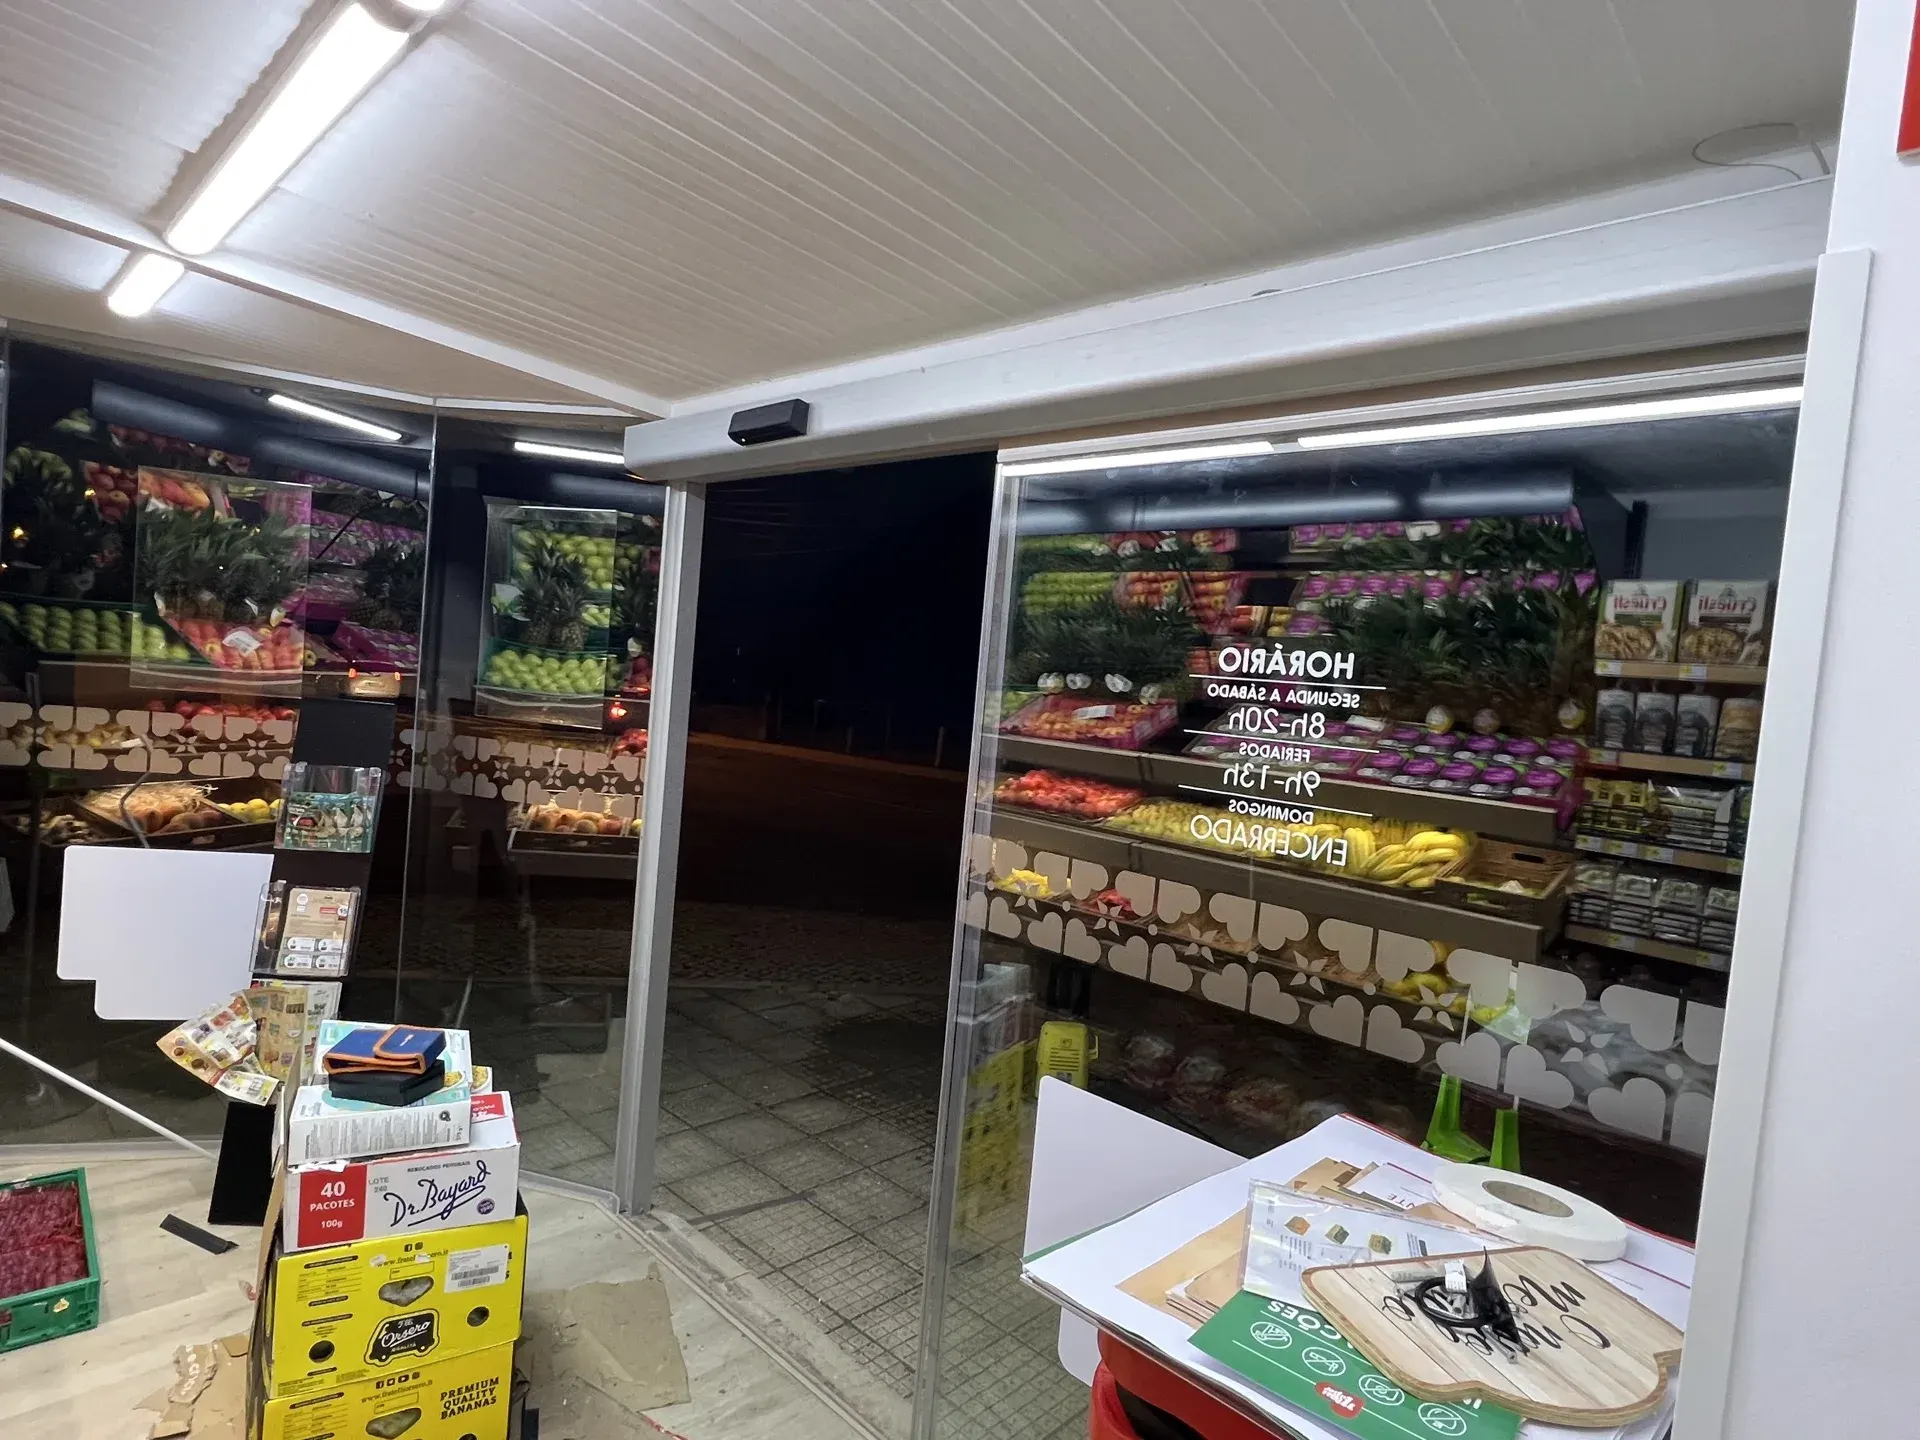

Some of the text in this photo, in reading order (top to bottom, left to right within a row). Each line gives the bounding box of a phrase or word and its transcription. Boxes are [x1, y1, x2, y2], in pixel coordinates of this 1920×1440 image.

[320, 1181, 346, 1198] 40
[368, 1176, 390, 1185] LOTE
[310, 1199, 355, 1212] PACOTES
[383, 1160, 491, 1228] Dr. Bayard
[321, 1219, 343, 1229] 100g
[381, 1321, 431, 1348] Orsero
[440, 1377, 499, 1401] PREMIUM
[443, 1387, 496, 1411] QUALITY
[440, 1396, 497, 1420] BANANAS
